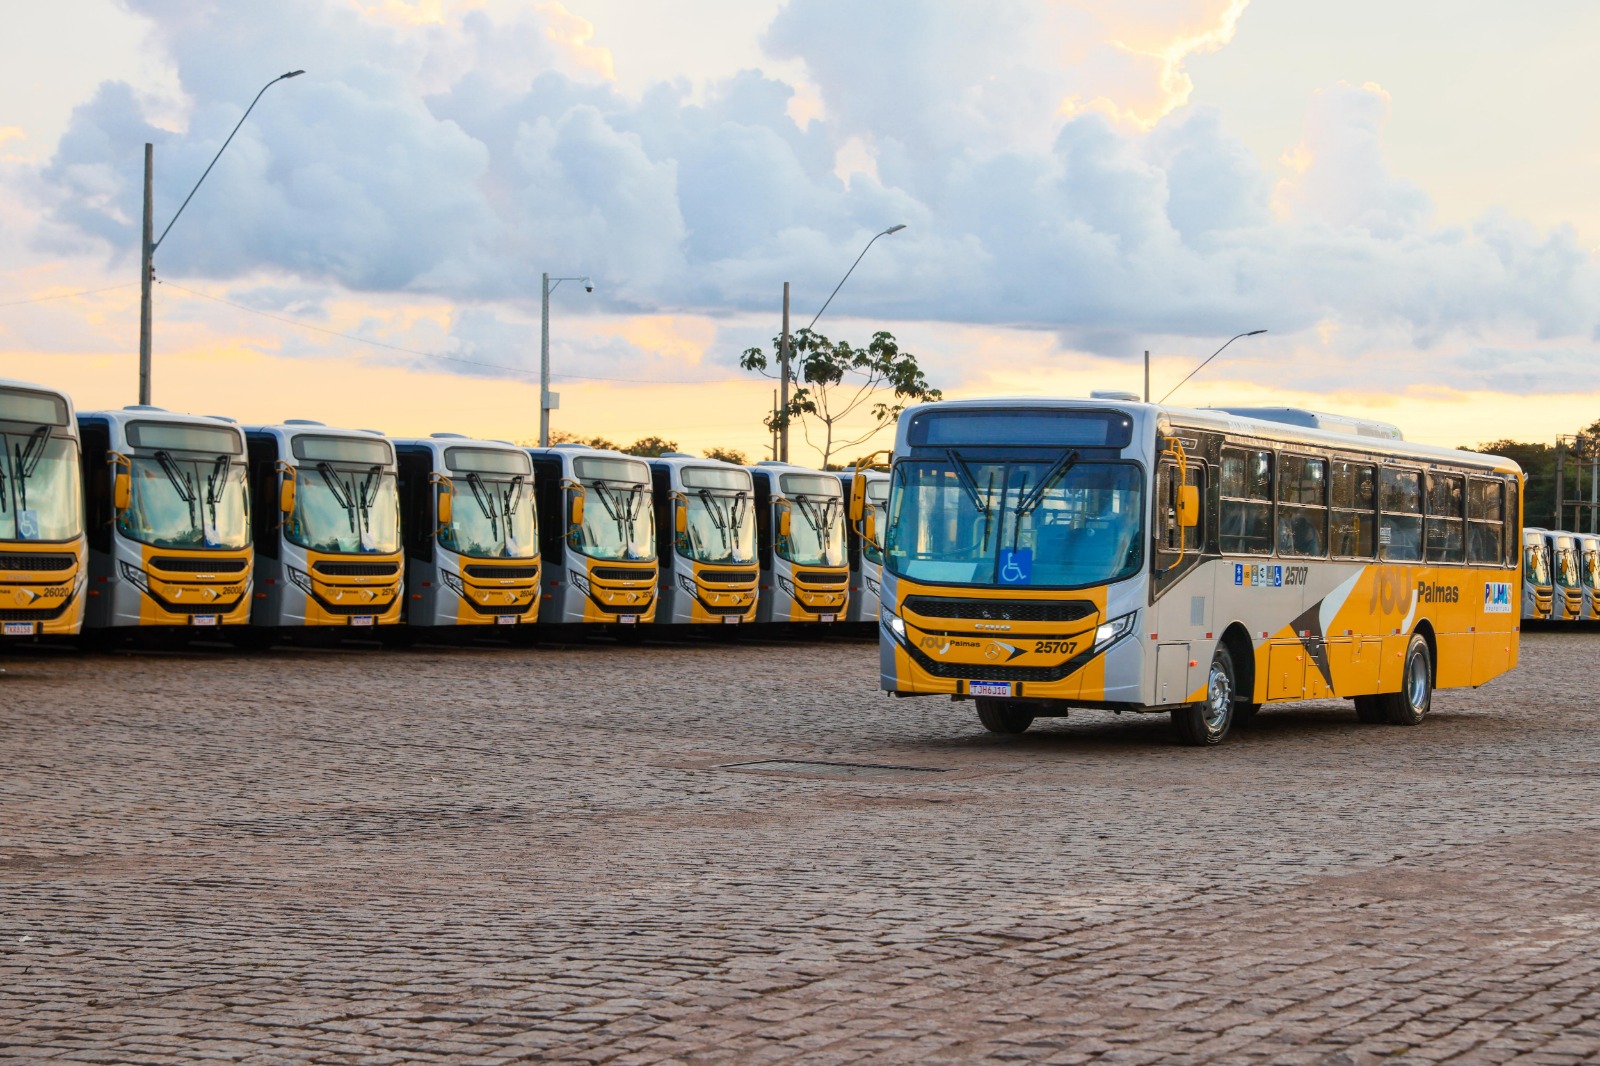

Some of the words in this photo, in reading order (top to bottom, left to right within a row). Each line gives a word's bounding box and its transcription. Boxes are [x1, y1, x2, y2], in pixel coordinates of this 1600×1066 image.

[1285, 566, 1308, 586] 25707
[43, 587, 70, 597] 26020
[1417, 580, 1459, 603] Palmas
[1485, 583, 1511, 604] PALMAS
[949, 639, 981, 648] Palmas
[1034, 641, 1078, 654] 25707
[973, 686, 1007, 695] TJH6J10
